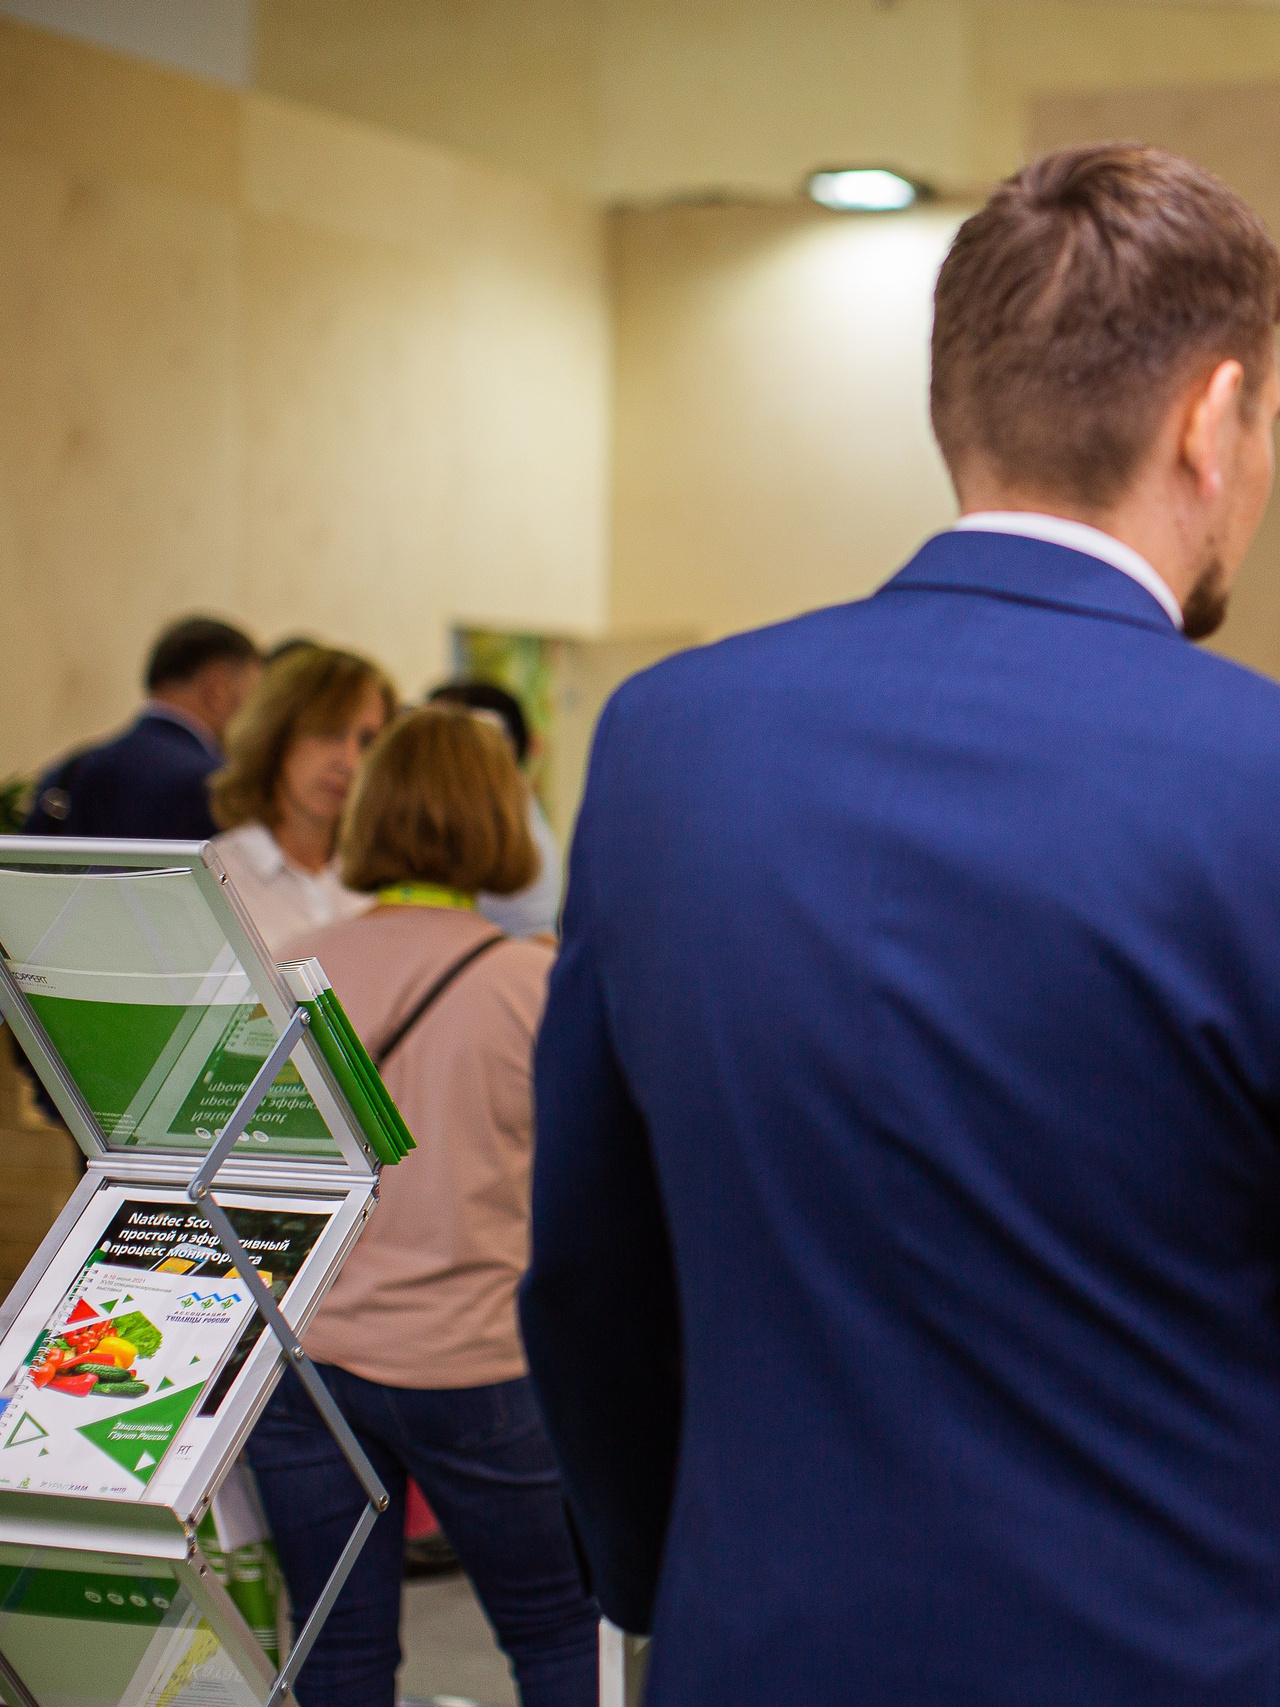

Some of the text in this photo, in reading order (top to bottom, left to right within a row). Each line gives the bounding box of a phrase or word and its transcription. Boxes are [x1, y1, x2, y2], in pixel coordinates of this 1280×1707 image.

[128, 1212, 184, 1227] Natutec
[118, 1229, 176, 1242] простой
[176, 1233, 188, 1242] и
[110, 1243, 164, 1257] процесс
[137, 1432, 169, 1440] России
